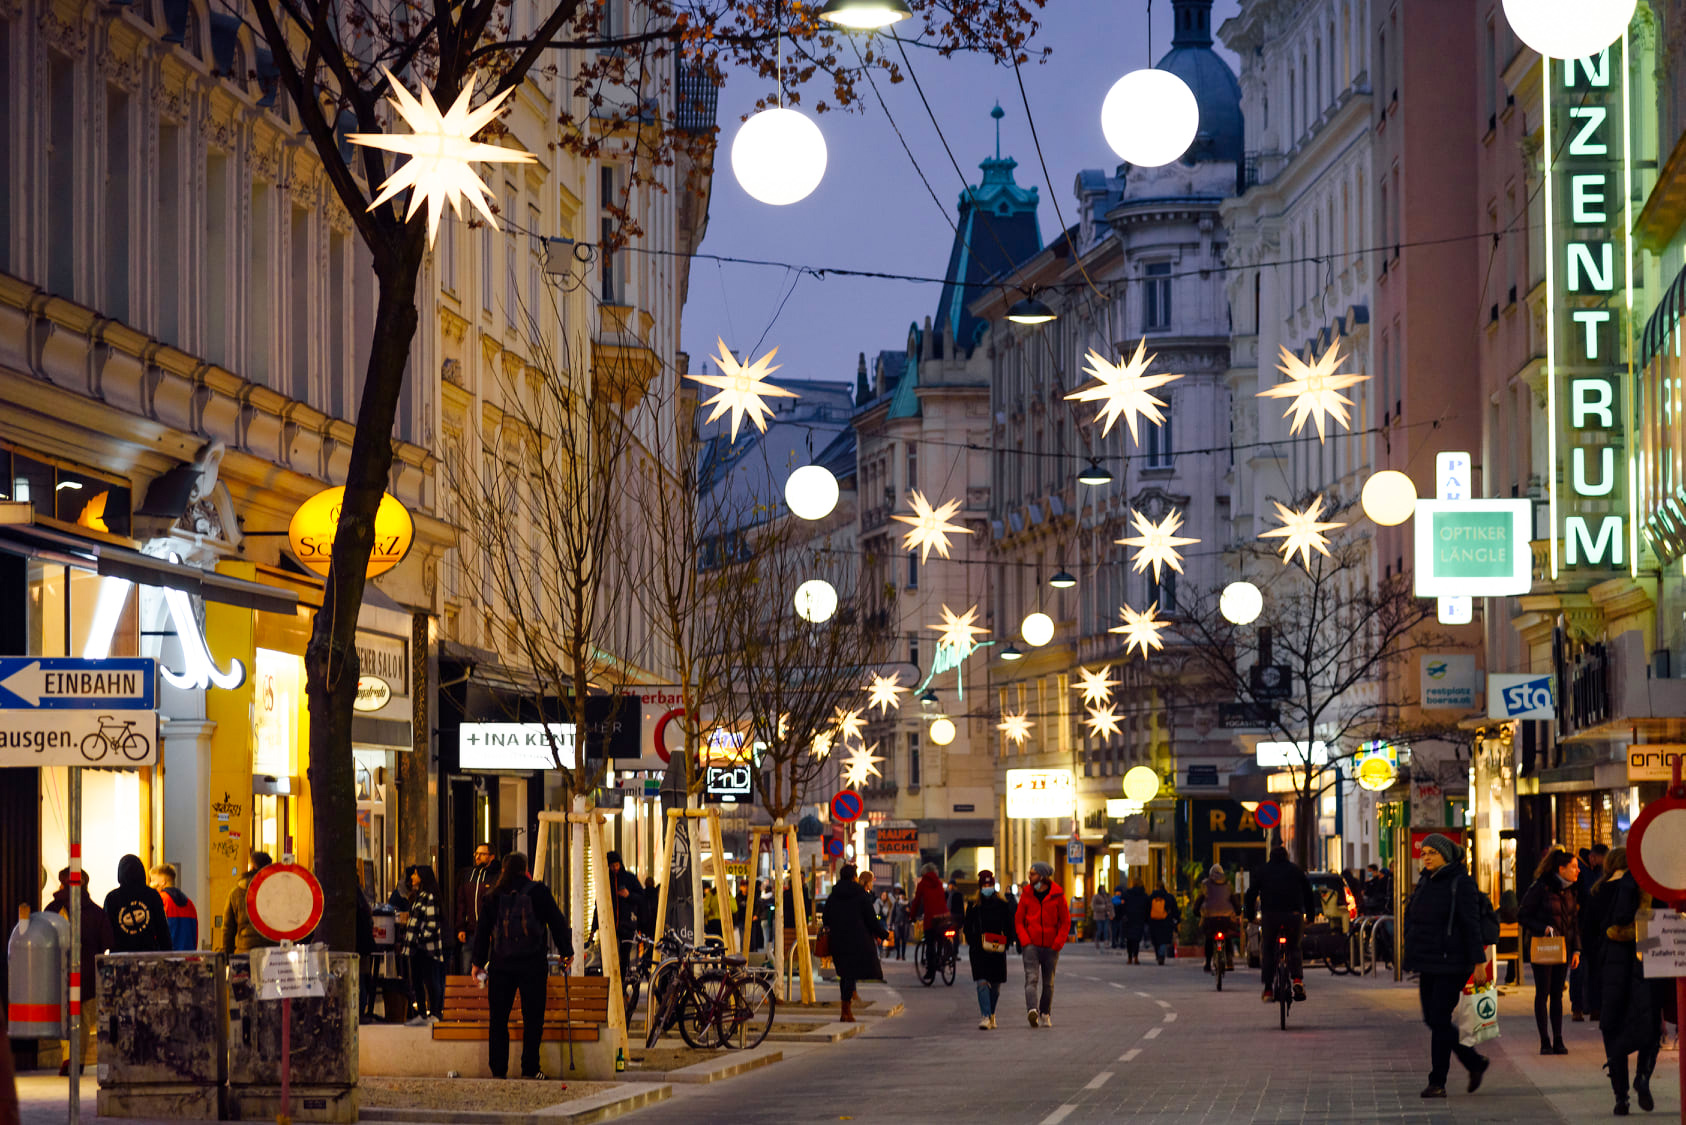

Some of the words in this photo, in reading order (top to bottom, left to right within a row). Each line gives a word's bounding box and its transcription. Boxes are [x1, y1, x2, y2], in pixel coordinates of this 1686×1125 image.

[1439, 526, 1506, 541] OPTIKER
[300, 536, 400, 557] SCRZ
[1440, 546, 1506, 562] LÄNGLE
[378, 651, 403, 680] SALON
[45, 673, 136, 695] EINBAHN
[1426, 687, 1471, 696] restplatz
[0, 730, 78, 753] ausgen.
[484, 733, 519, 747] INA
[525, 733, 575, 747] KENT
[878, 829, 917, 840] HAUPT
[879, 843, 917, 852] SACHE
